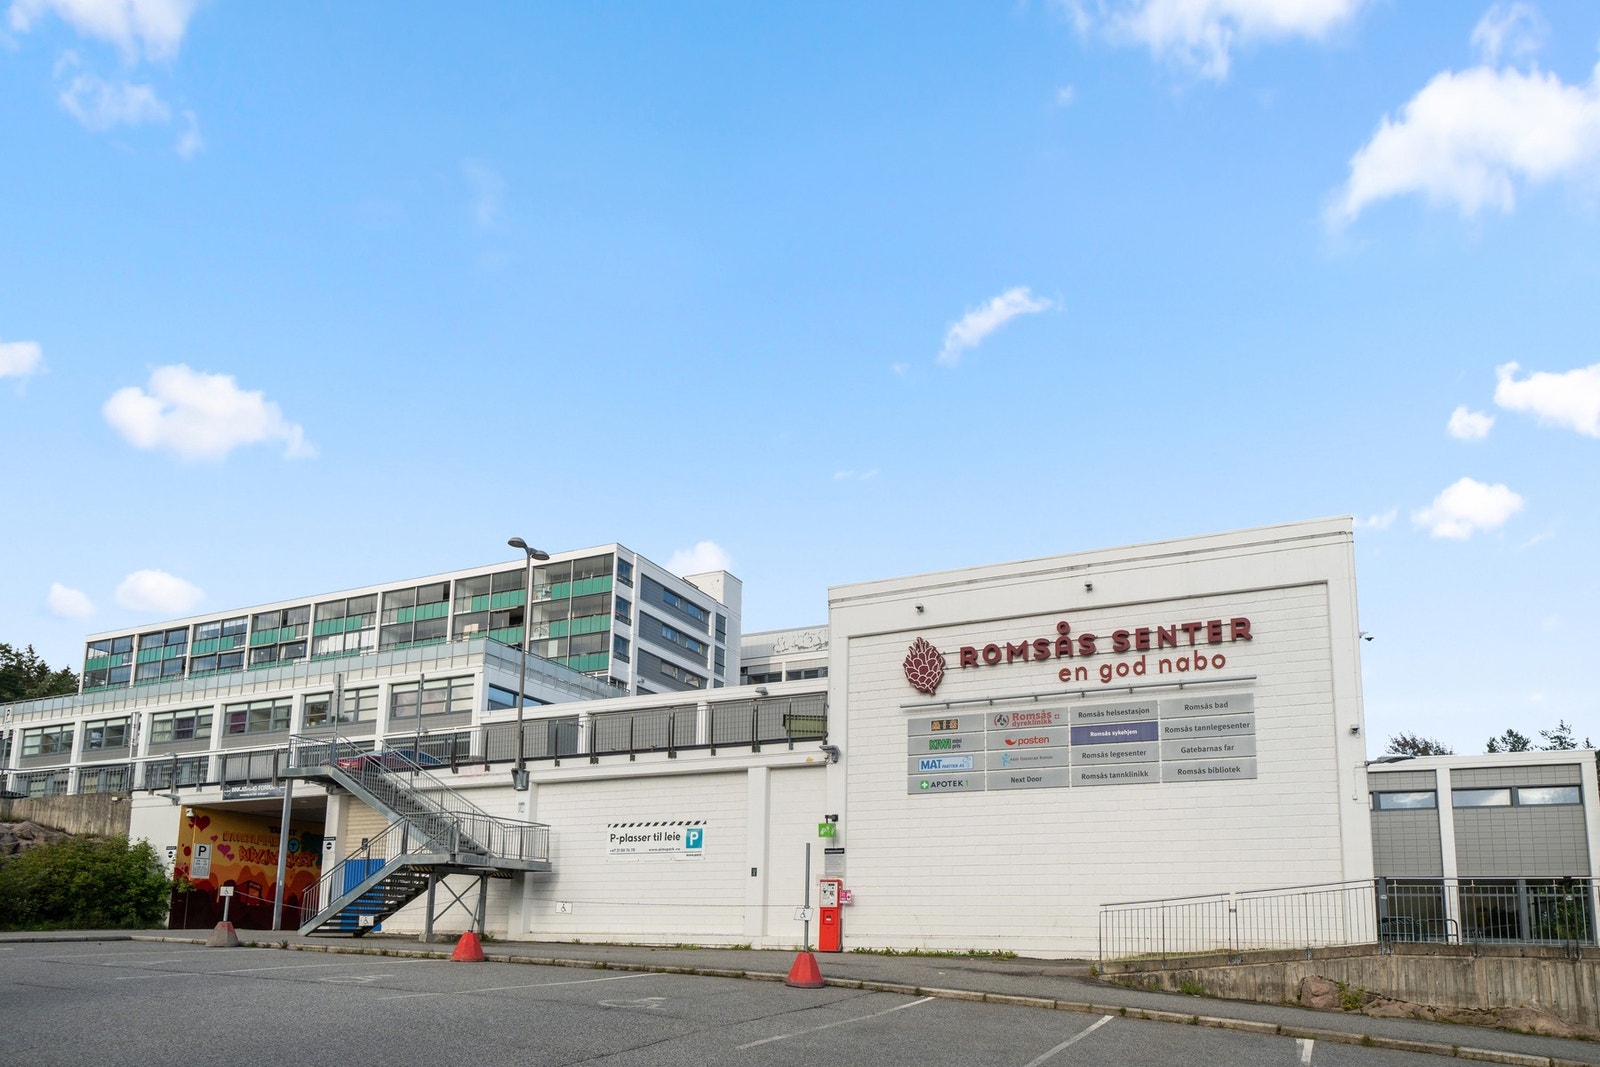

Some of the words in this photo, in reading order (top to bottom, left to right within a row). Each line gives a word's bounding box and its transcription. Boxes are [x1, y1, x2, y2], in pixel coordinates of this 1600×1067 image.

[960, 621, 1096, 668] ROMSÅS
[1112, 617, 1253, 652] SENTER
[1058, 664, 1087, 682] en
[1099, 655, 1146, 683] god
[1158, 650, 1226, 674] nabo
[1184, 703, 1213, 711] Romsås
[1214, 701, 1228, 709] bad
[1012, 710, 1052, 720] Romsås
[1078, 710, 1104, 718] Romsås
[1106, 708, 1149, 717] helsestasjon
[1012, 718, 1053, 728] dyreklinikk
[1165, 725, 1193, 733] Romsås
[1194, 722, 1250, 732] tannlegesenter
[1112, 729, 1137, 737] sykehjem
[929, 738, 951, 750] KIWI
[1018, 736, 1049, 746] posten
[1181, 746, 1222, 754] Gatebarnas
[1224, 744, 1234, 752] far
[1082, 751, 1108, 759] Romsås
[1110, 750, 1146, 758] legesenter
[920, 759, 942, 770] MAT
[1081, 772, 1108, 780] Romsås
[1109, 770, 1148, 779] tannklinikk
[1178, 767, 1206, 775] Romsås
[1208, 765, 1241, 774] bibliotek
[931, 780, 963, 788] APOTEK
[610, 833, 650, 844] P-plasser
[653, 832, 662, 841] til
[664, 832, 681, 841] leie
[690, 831, 699, 846] P
[198, 845, 207, 857] P
